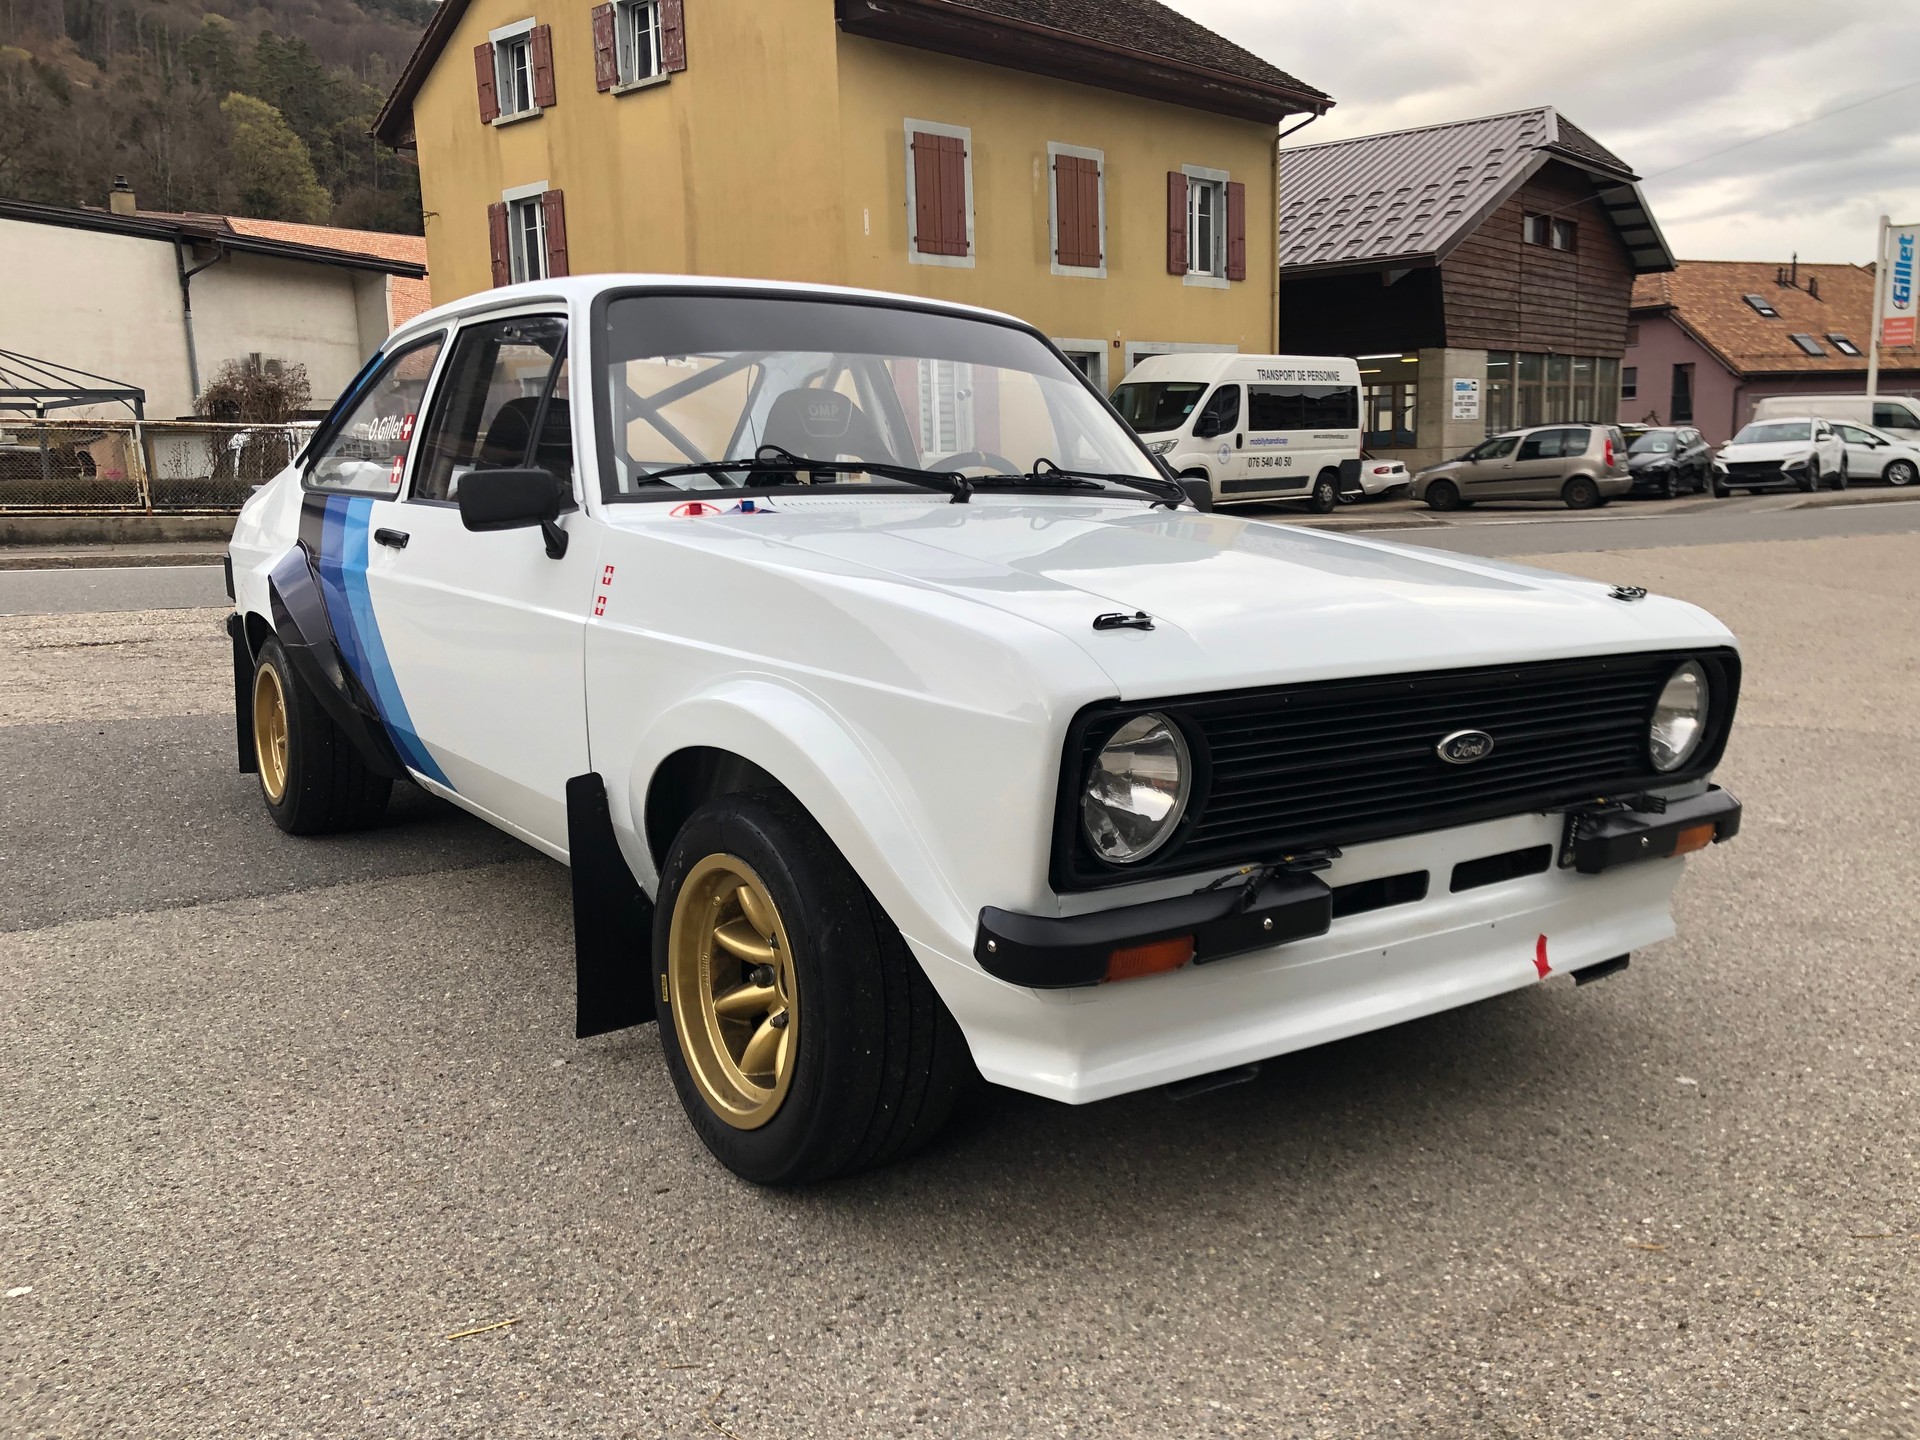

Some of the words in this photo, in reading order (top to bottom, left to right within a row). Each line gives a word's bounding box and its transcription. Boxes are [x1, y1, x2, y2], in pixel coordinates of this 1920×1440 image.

[1893, 234, 1914, 303] Gillet
[1257, 369, 1296, 381] TRANSPORT
[1297, 370, 1306, 381] DE
[1307, 370, 1340, 381] PERSONNE
[808, 404, 840, 418] OMP
[369, 415, 404, 440] O.Gillet
[1248, 457, 1260, 468] 076
[1261, 457, 1273, 467] 540
[1274, 457, 1282, 467] 40
[1284, 456, 1292, 467] 50
[1453, 737, 1485, 758] Ford
